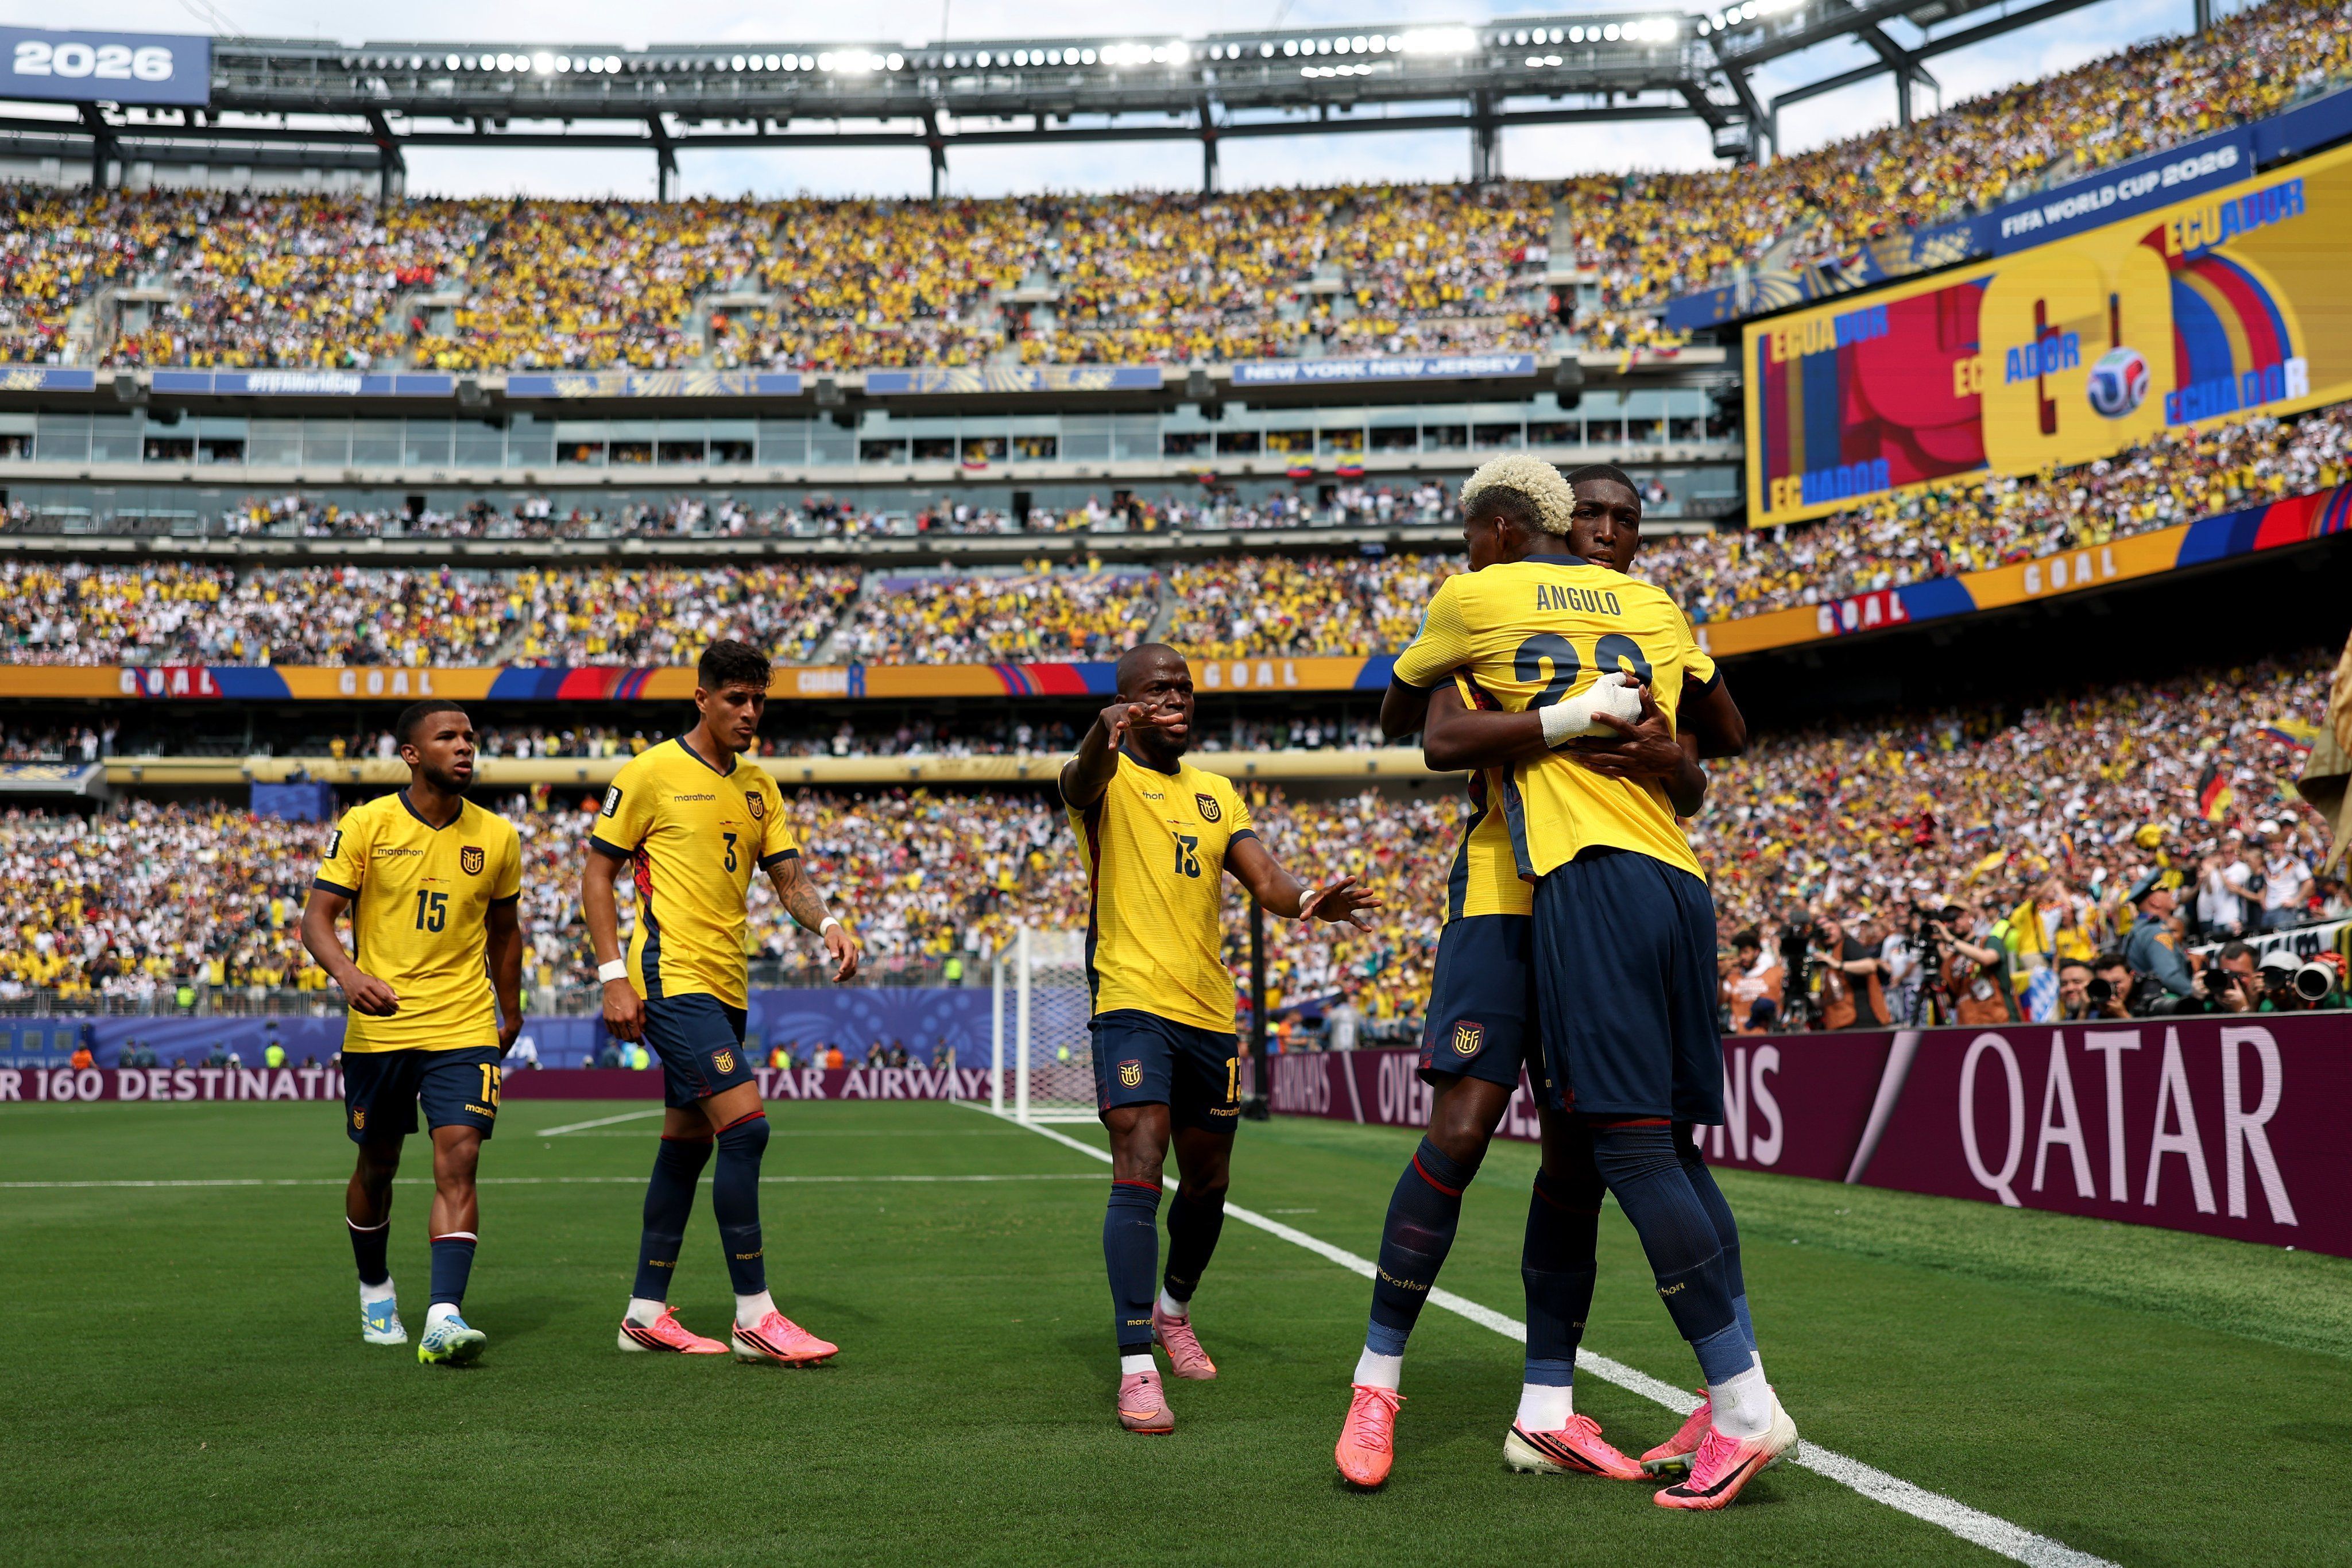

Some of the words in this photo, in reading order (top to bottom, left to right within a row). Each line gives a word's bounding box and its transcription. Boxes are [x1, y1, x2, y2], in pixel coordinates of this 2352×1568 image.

[13, 40, 173, 82] 2026
[2001, 208, 2043, 238] FIFA
[2043, 185, 2117, 224] WORLD
[2117, 171, 2161, 201] CUP
[2161, 145, 2239, 188] 2026
[2165, 178, 2304, 257] ECUADOR
[1771, 304, 1889, 363] ECUADOR
[1243, 364, 1299, 380] NEW
[1302, 362, 1367, 378] YORK
[1370, 361, 1426, 377] NEW
[1428, 357, 1522, 374] JERSEY
[2005, 332, 2080, 384] ADOR
[2165, 357, 2309, 427] ECUADOR
[1771, 458, 1890, 508] ECUADOR
[2024, 548, 2117, 594] GOAL
[1537, 584, 1621, 615] ANGULO
[1817, 591, 1904, 633] GOAL
[119, 668, 214, 695] GOAL
[340, 669, 433, 696] GOAL
[1204, 661, 1298, 688] GOAL
[674, 793, 715, 802] marathon
[378, 848, 424, 856] marathon
[724, 833, 737, 873] 3
[1172, 831, 1201, 878] 13
[416, 889, 448, 932] 15
[36, 1069, 103, 1101] 160
[479, 1063, 501, 1107] 15
[755, 1068, 827, 1099] TAR
[1959, 1026, 2298, 1226] QATAR
[1378, 1265, 1427, 1291] marathon
[1548, 1436, 1557, 1445] JOEL
